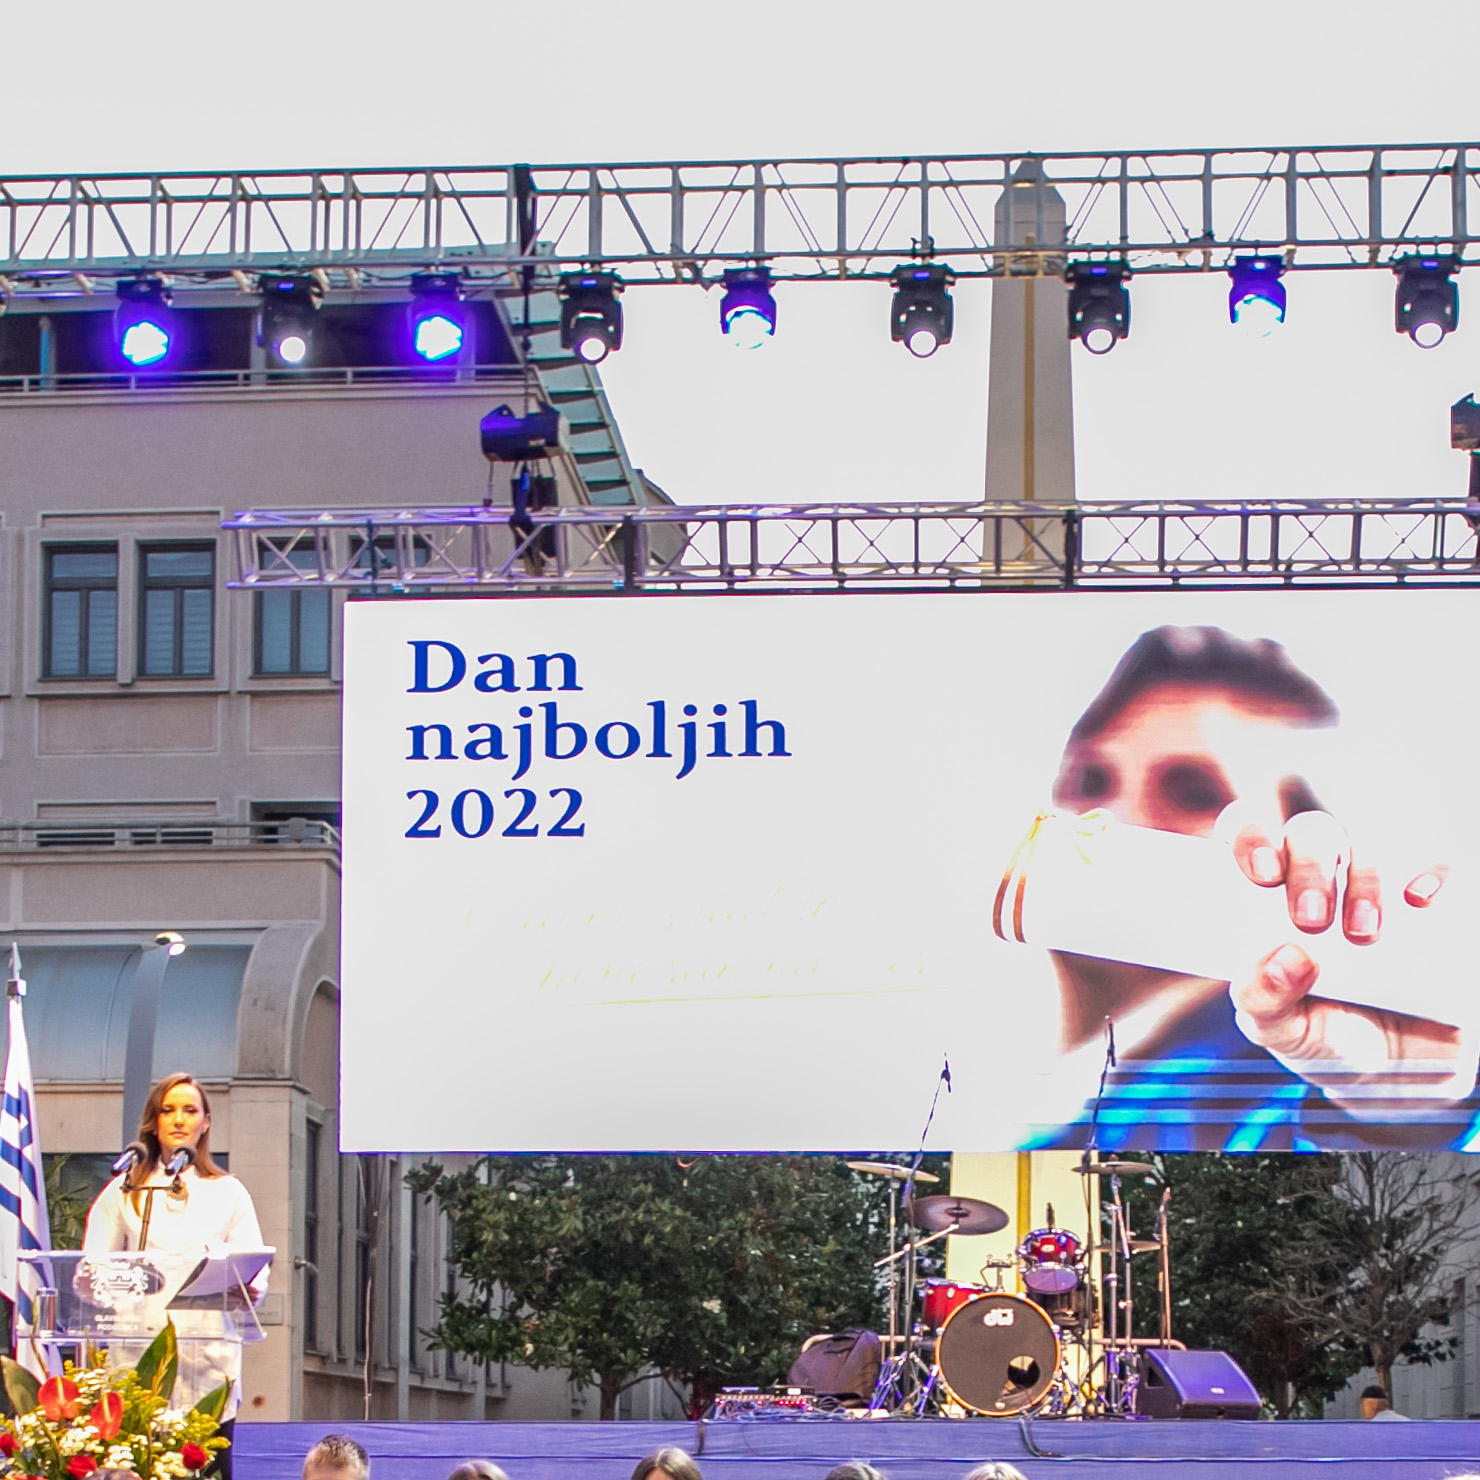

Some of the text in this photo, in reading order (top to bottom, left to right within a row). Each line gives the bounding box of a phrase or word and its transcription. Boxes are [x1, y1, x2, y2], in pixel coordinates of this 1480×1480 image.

[406, 640, 584, 693] Dan
[405, 699, 793, 781] najboljih
[404, 788, 586, 839] 2022
